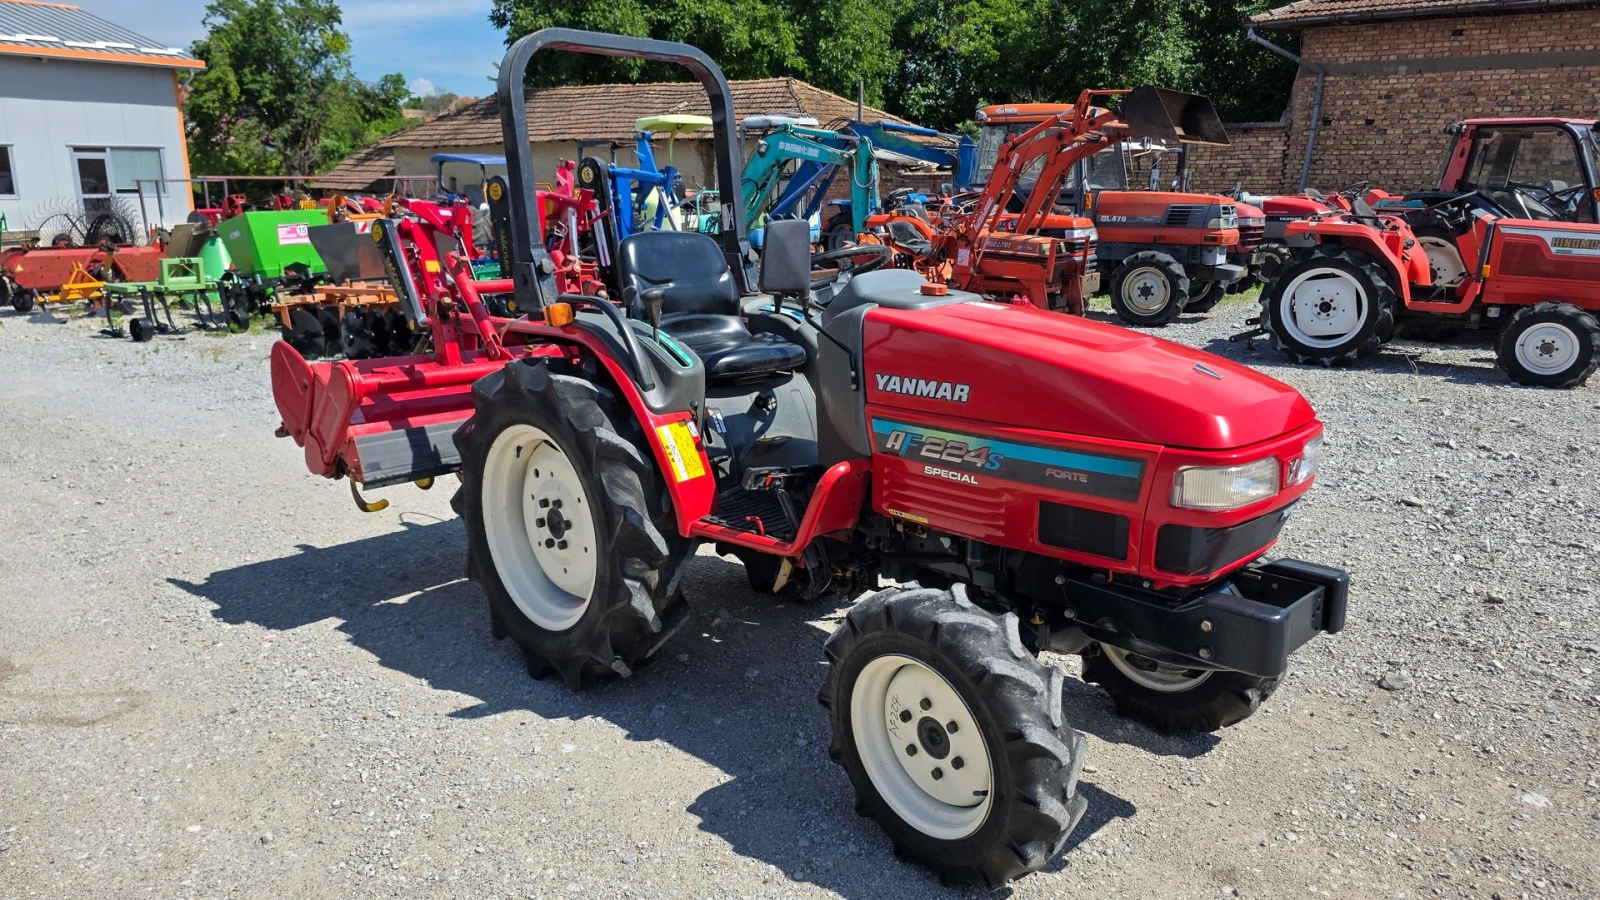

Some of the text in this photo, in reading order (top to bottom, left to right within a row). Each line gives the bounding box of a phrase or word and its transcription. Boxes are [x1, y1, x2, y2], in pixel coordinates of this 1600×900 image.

[1100, 215, 1127, 223] GL470
[298, 226, 307, 234] 15
[874, 373, 970, 403] YANMAR
[924, 465, 979, 485] SPECIAL
[1045, 467, 1088, 483] FORTE
